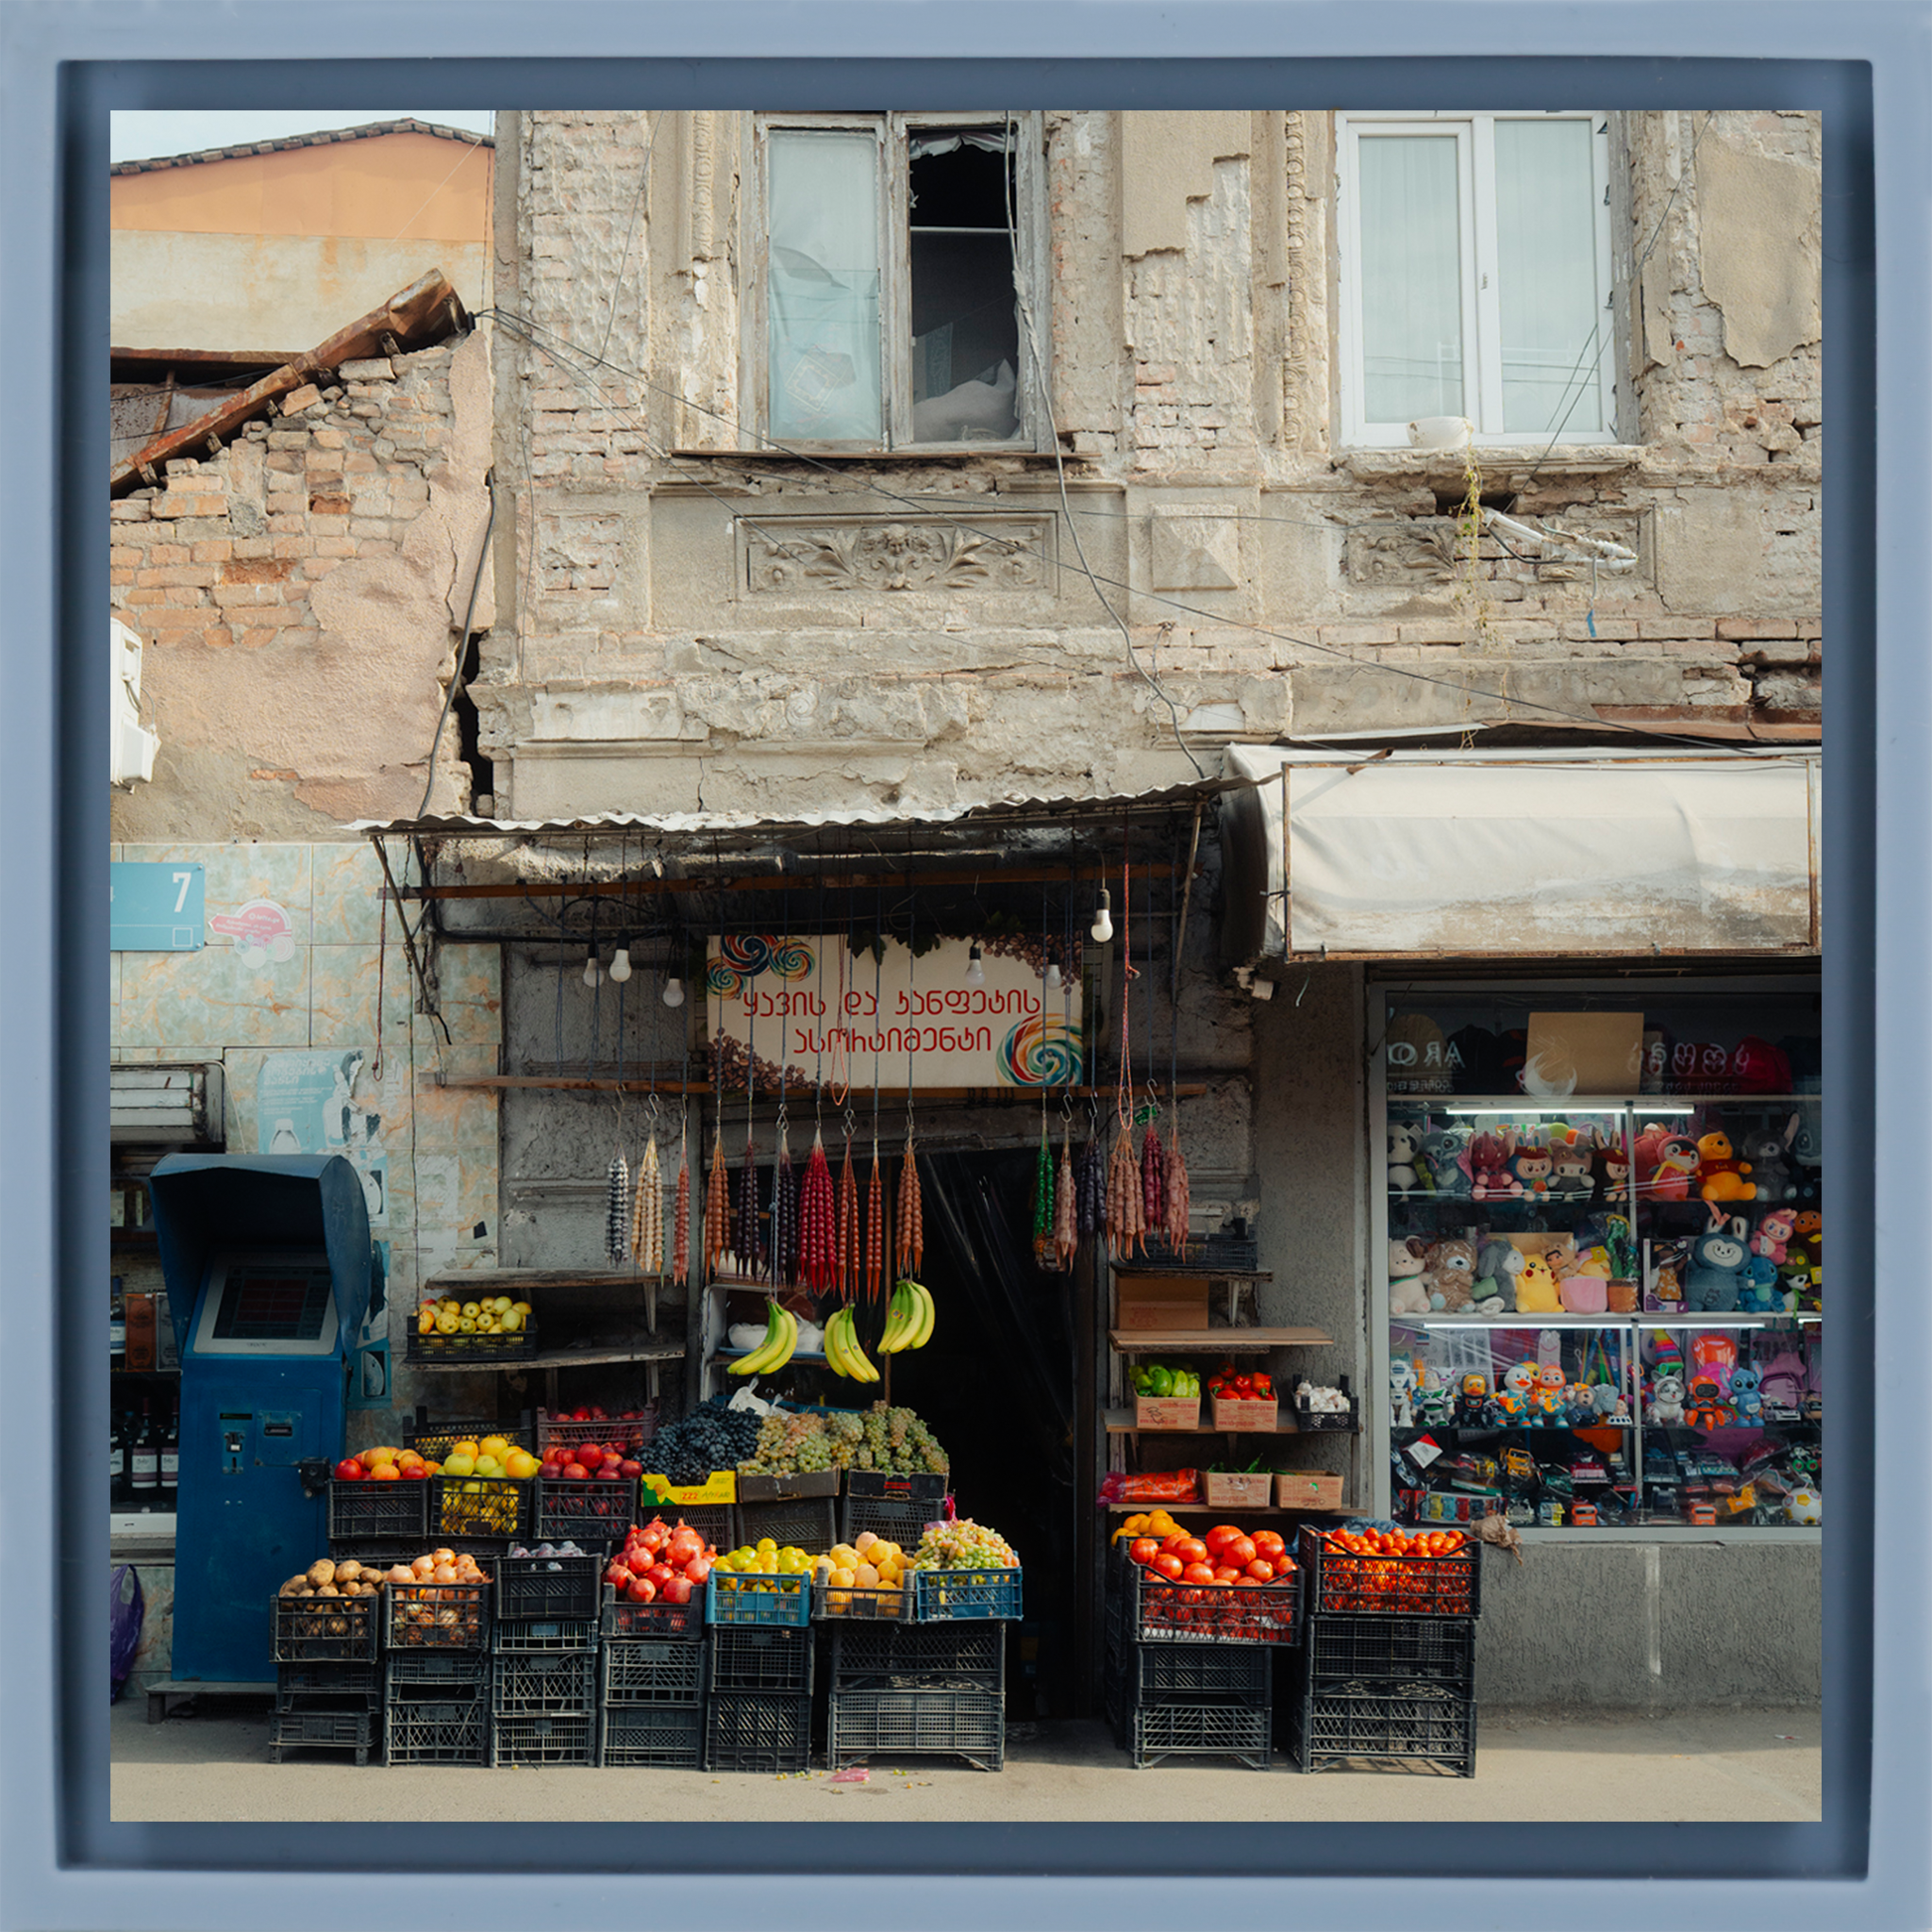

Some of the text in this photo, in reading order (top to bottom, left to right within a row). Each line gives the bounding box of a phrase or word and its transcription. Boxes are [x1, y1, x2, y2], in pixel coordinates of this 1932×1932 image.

[173, 872, 192, 913] 7
[743, 989, 1041, 1017] ყავის და კანფეტის
[793, 1026, 991, 1054] ასორტიმენტი
